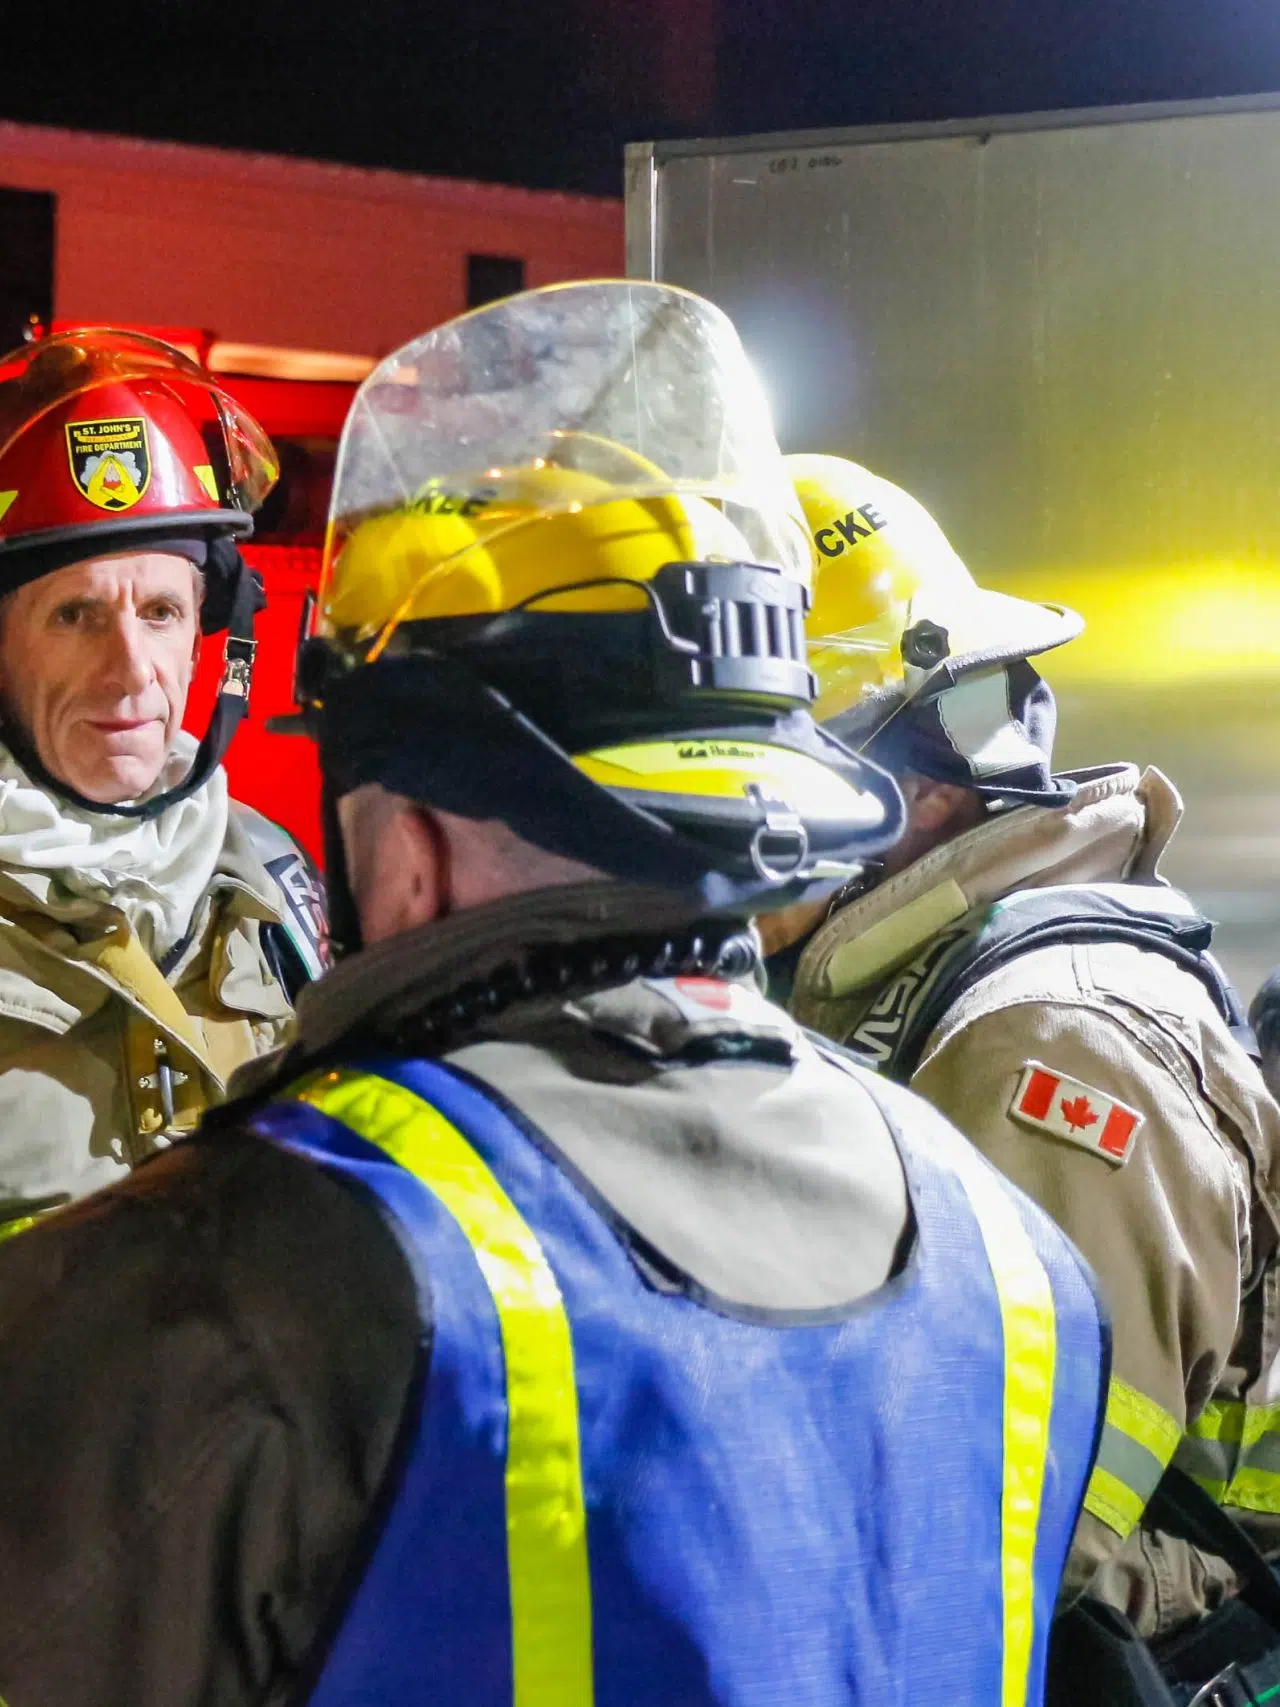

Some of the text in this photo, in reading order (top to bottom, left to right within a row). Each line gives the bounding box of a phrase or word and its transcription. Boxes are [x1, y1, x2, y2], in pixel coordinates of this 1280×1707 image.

[82, 424, 131, 436] ST. JOHN'S
[75, 441, 142, 454] FIRE DEPARTMENT
[814, 503, 888, 567] CKE
